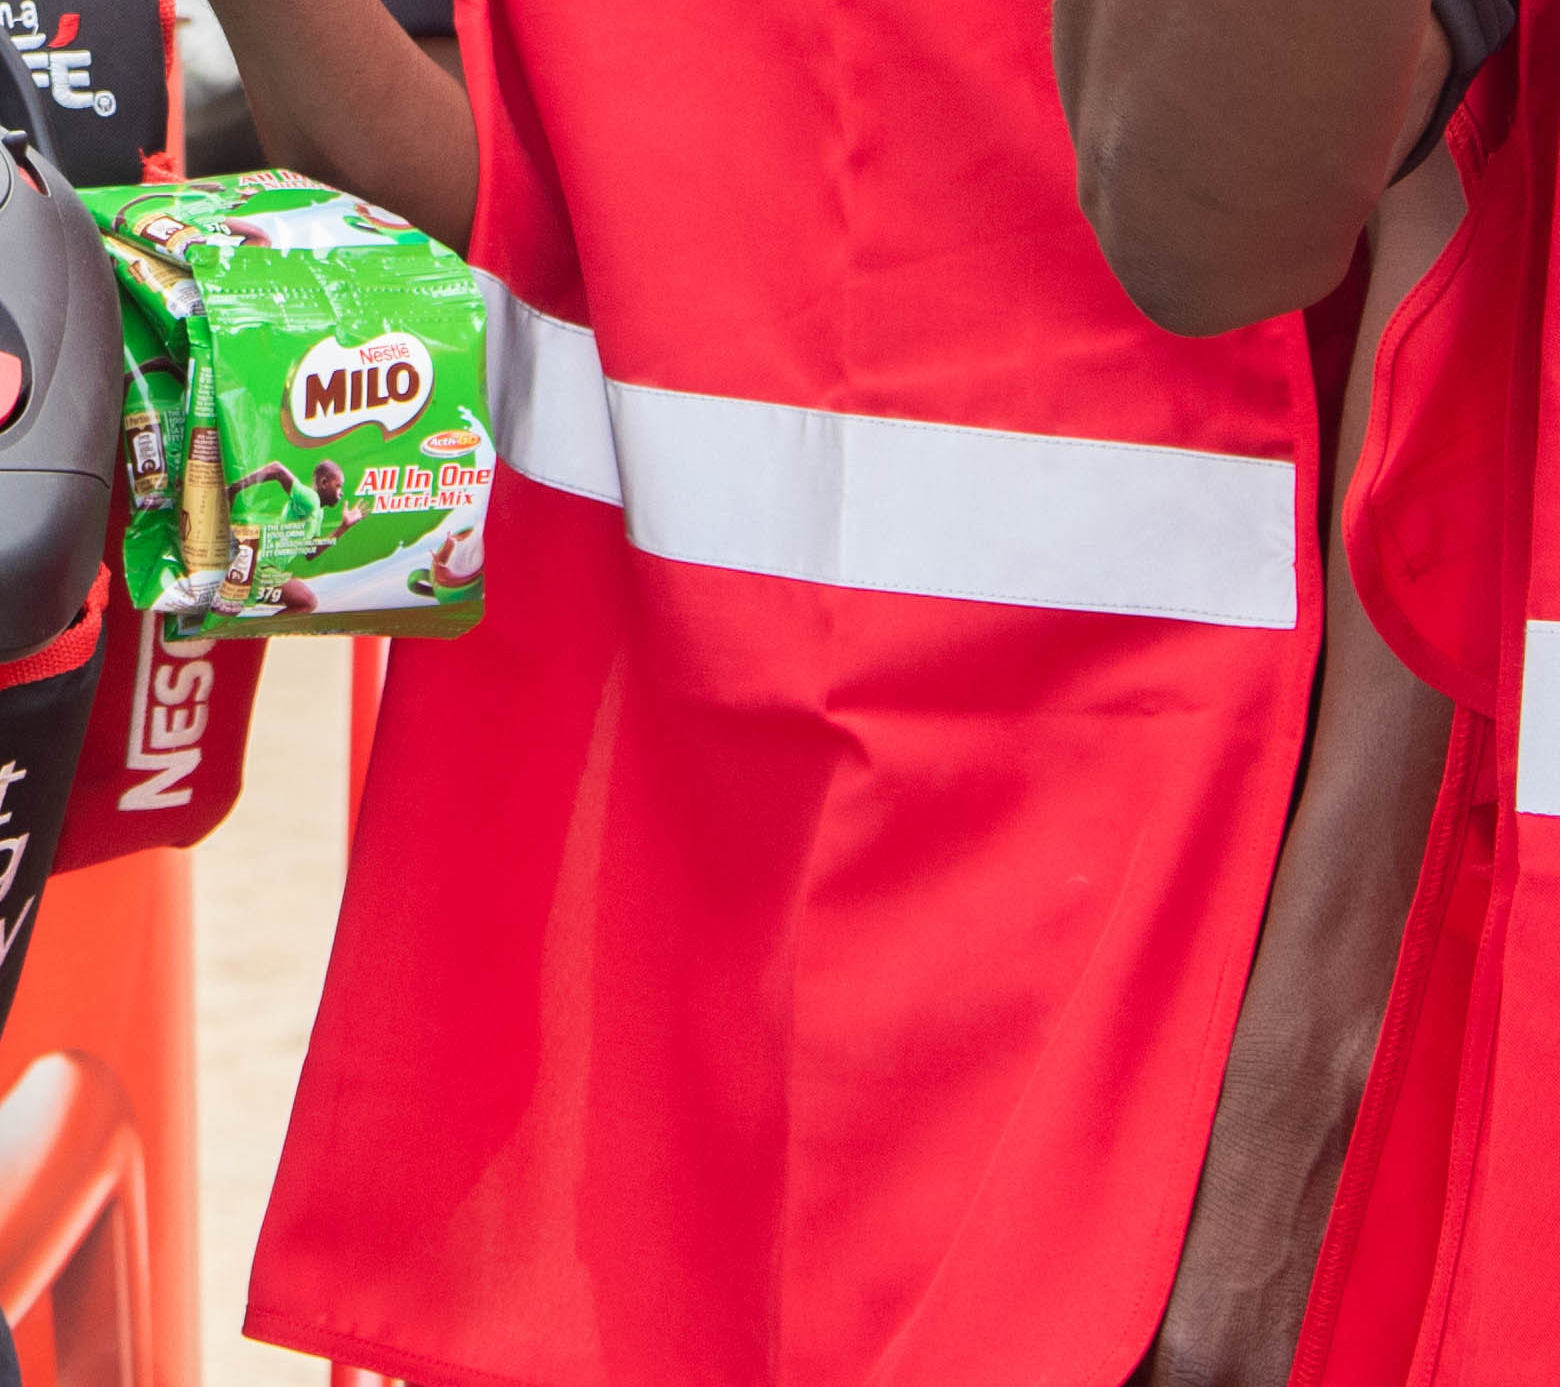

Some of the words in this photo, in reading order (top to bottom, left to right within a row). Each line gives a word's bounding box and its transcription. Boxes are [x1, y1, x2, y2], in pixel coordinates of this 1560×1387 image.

[360, 342, 411, 364] Nestlé
[305, 362, 420, 421] MILO
[361, 468, 396, 494] All
[407, 468, 431, 490] In
[442, 465, 491, 487] One
[375, 490, 473, 510] Nutri-Mix
[256, 587, 282, 604] 37g
